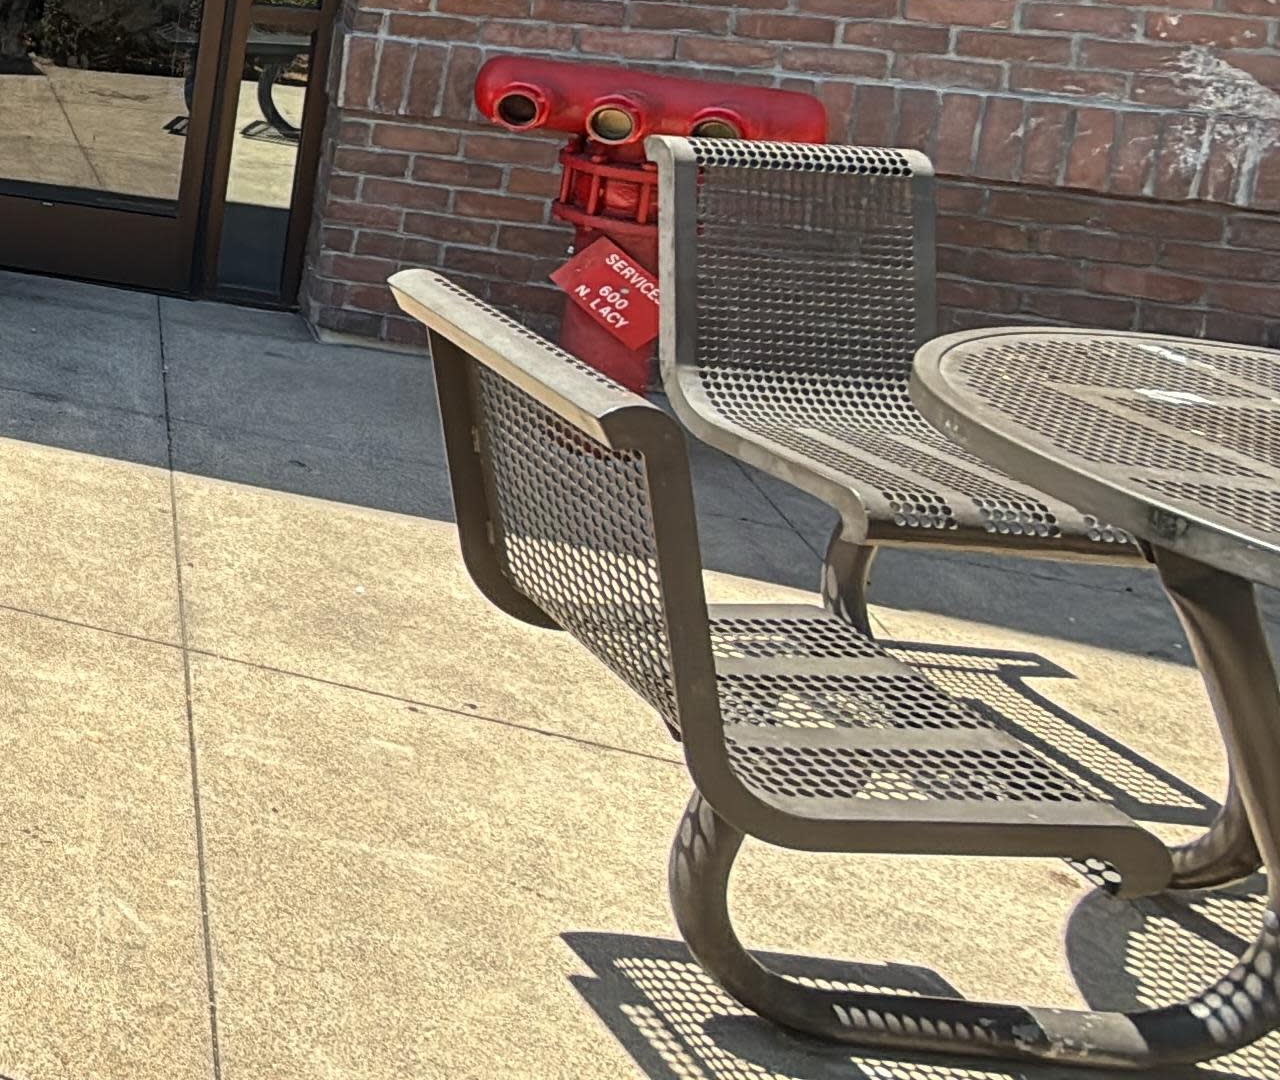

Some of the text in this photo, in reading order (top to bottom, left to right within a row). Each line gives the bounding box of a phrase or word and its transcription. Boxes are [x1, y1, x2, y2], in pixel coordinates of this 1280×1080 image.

[574, 284, 629, 329] N. LACY
[599, 285, 629, 310] 600
